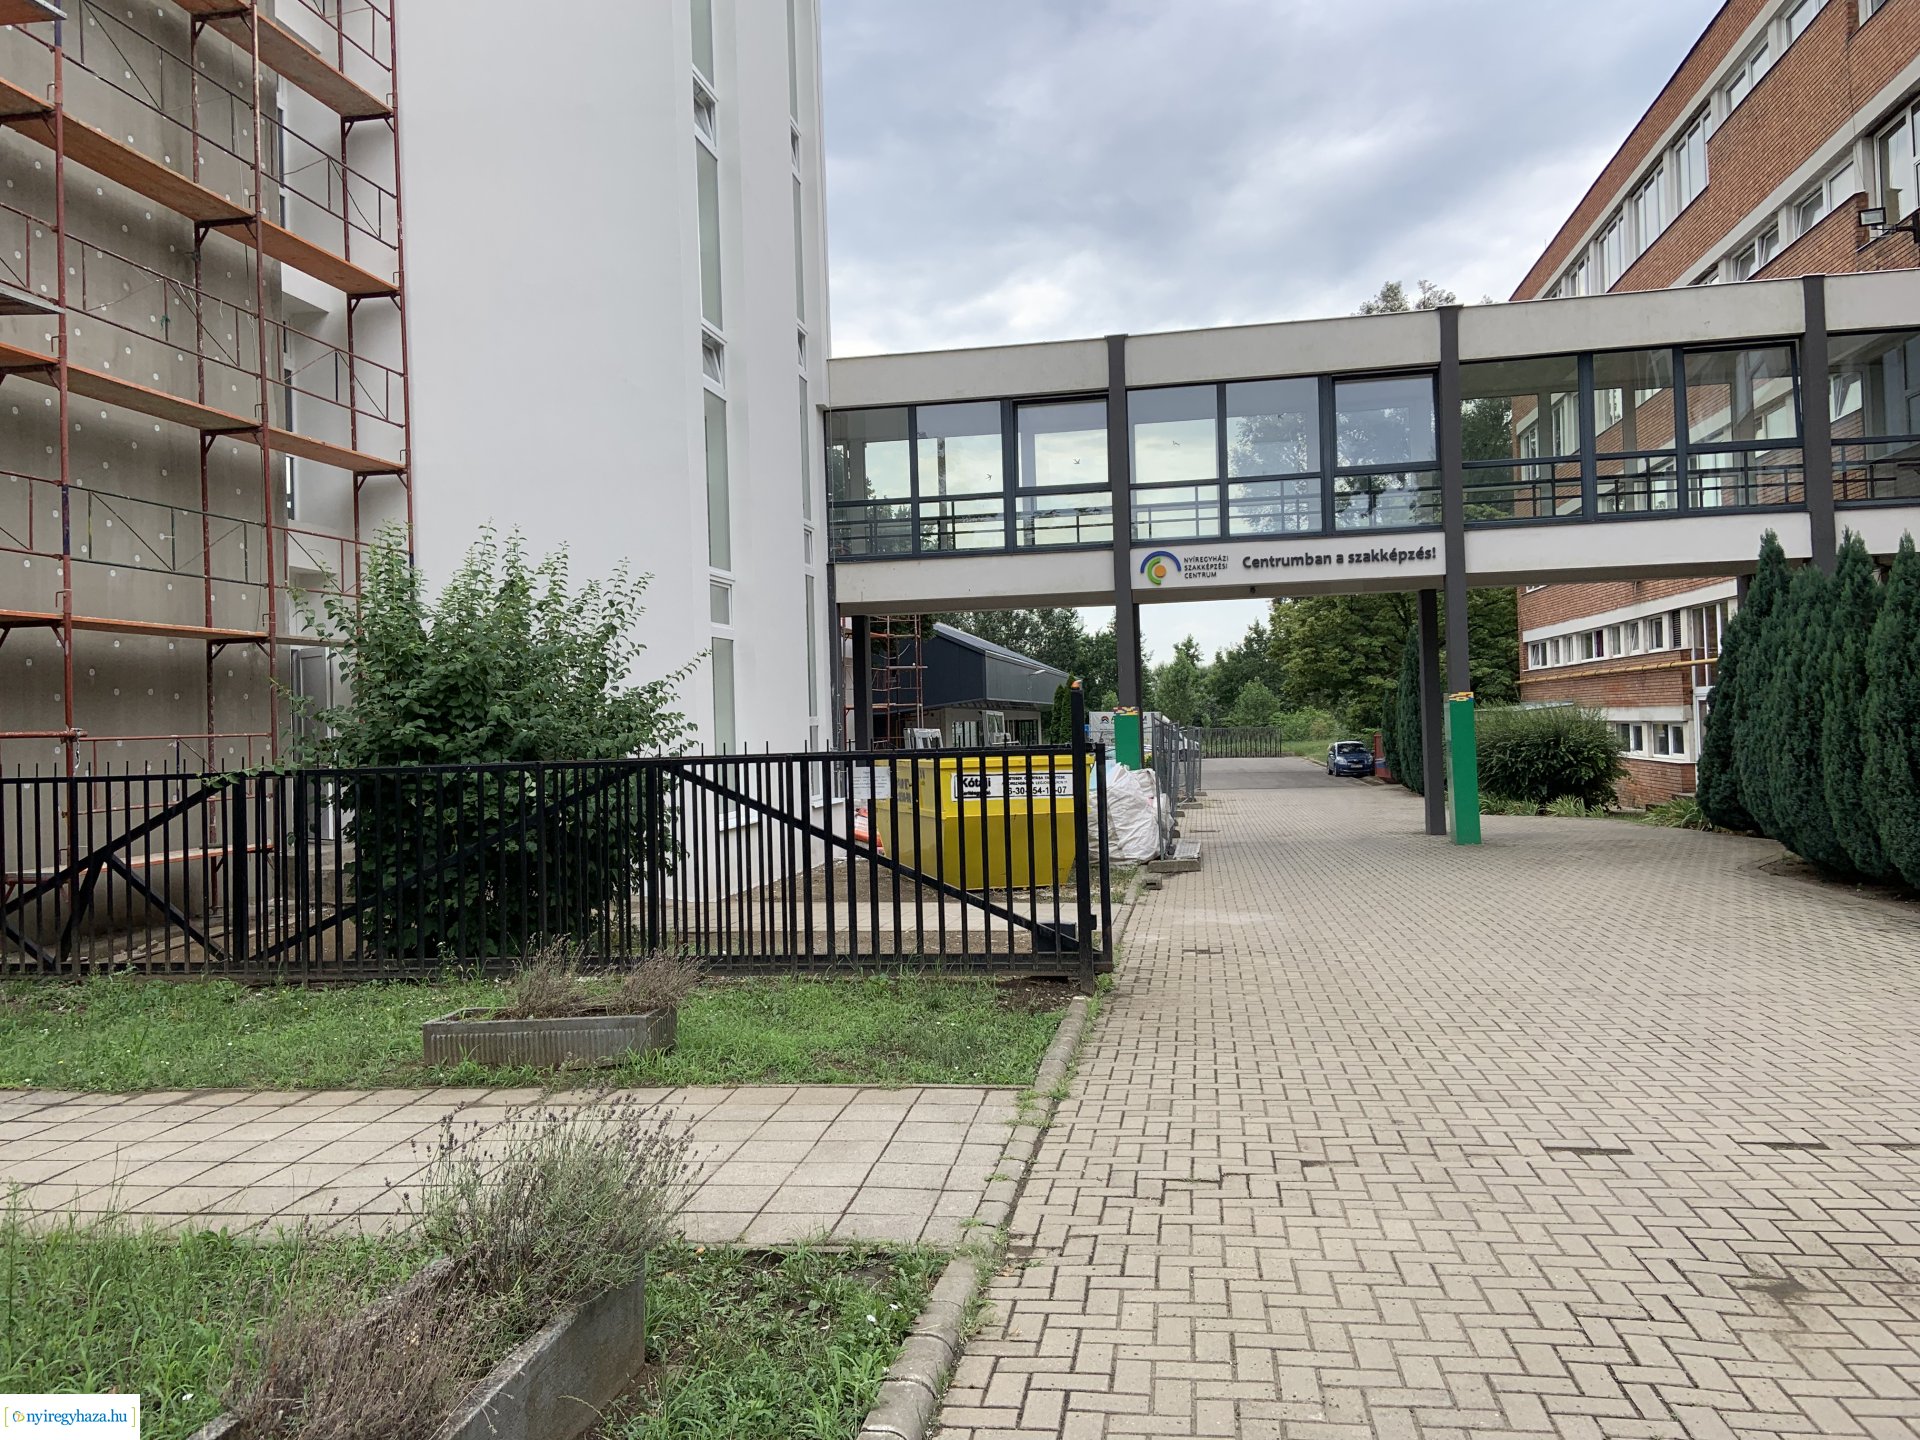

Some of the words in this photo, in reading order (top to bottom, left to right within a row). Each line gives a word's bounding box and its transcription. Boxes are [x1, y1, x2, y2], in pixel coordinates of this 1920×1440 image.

[1183, 554, 1229, 563] NYÍREGYHÁZI
[1242, 552, 1332, 569] Centrumban
[1336, 553, 1344, 565] a
[1347, 547, 1437, 565] szakképzés!
[1184, 562, 1228, 571] SZAKKÉPZÉSI
[1184, 571, 1217, 579] CENTRUM
